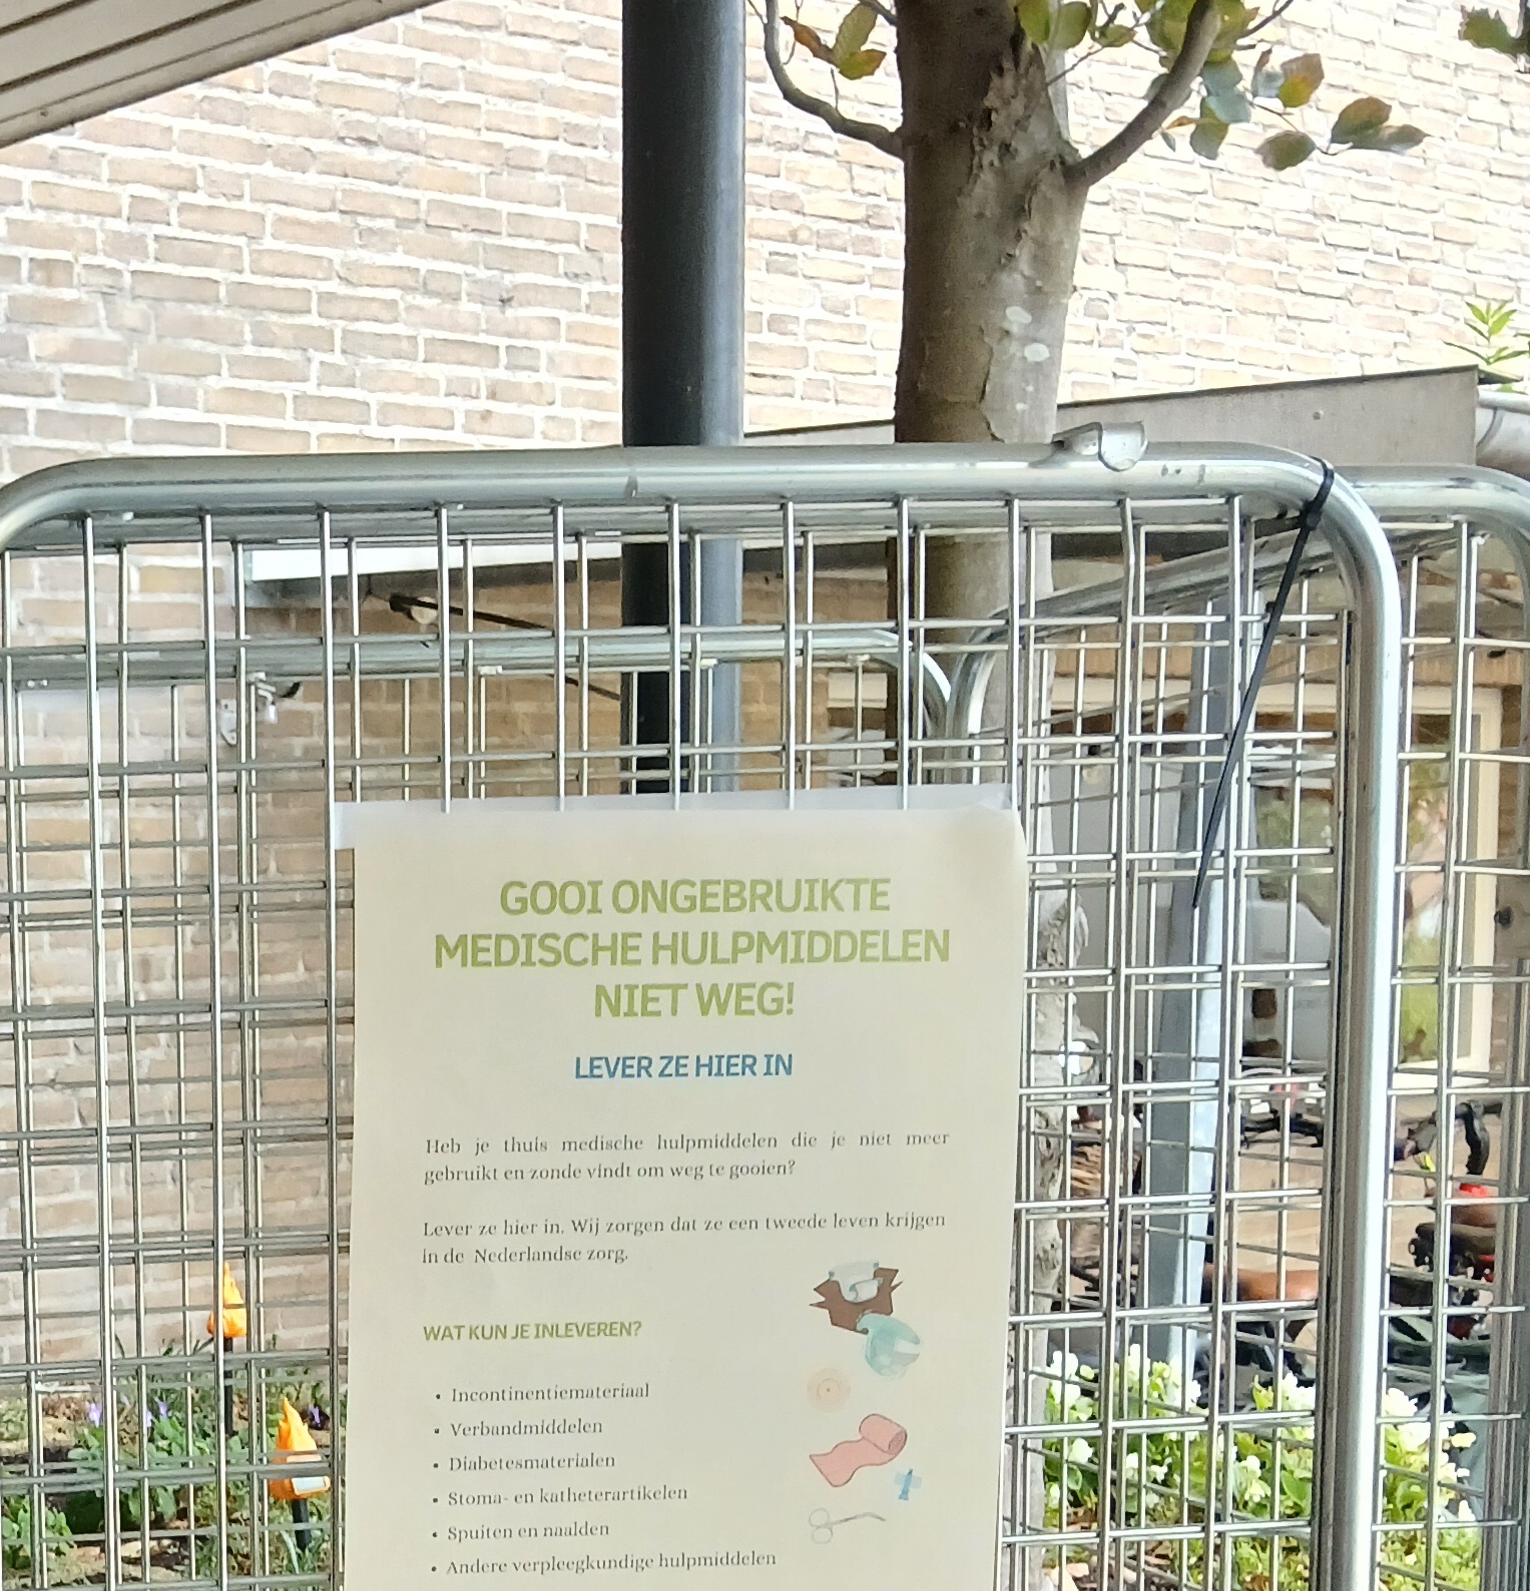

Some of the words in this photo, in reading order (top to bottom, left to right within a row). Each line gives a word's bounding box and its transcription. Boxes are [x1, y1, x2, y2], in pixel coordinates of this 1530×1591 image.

[499, 879, 603, 916] GOOI
[612, 877, 891, 914] ONGEBRUIKTE
[434, 931, 642, 968] MEDISCHE
[651, 928, 950, 966] HULPMIDDELEN
[594, 982, 688, 1018] NIET
[695, 981, 795, 1017] WEG!
[575, 1055, 653, 1080] LEVER
[658, 1055, 689, 1078] ZE
[695, 1054, 758, 1078] HIER
[763, 1053, 793, 1077] IN
[426, 1138, 461, 1154] Heb
[475, 1137, 490, 1156] je
[504, 1136, 548, 1153] thuis
[561, 1134, 643, 1152] medische
[657, 1131, 778, 1153] hulpmiddelen
[791, 1131, 818, 1148] die
[830, 1131, 846, 1151] je
[858, 1130, 892, 1147] niet
[905, 1132, 950, 1147] meer
[424, 1164, 499, 1186] gebruikt
[503, 1168, 524, 1181] en
[530, 1162, 582, 1180] zonde
[586, 1162, 632, 1179] vindt
[637, 1165, 664, 1178] om
[670, 1163, 704, 1181] weg
[708, 1162, 725, 1177] te
[729, 1160, 796, 1181] gooien?
[423, 1221, 473, 1237] Lever
[479, 1223, 497, 1236] ze
[503, 1219, 538, 1236] hier
[544, 1218, 565, 1235] in.
[571, 1217, 600, 1236] Wij
[605, 1219, 664, 1236] zorgen
[670, 1216, 697, 1232] dat
[704, 1218, 723, 1231] ze
[728, 1218, 759, 1231] een
[765, 1213, 827, 1230] tweede
[833, 1212, 879, 1229] leven
[885, 1212, 945, 1230] krijgen
[422, 1248, 438, 1264] in
[443, 1248, 464, 1264] de
[474, 1245, 582, 1264] Nederlandse
[587, 1248, 629, 1264] zorg.
[423, 1325, 465, 1341] WAT
[468, 1324, 507, 1340] KUN
[511, 1324, 530, 1339] JE
[534, 1320, 642, 1339] INLEVEREN?
[451, 1382, 649, 1402] Incontinentiemateriaal
[451, 1418, 603, 1436] Verbandmiddelen
[449, 1453, 616, 1471] Diabetesmaterialen
[448, 1490, 508, 1506] Stoma-
[514, 1491, 534, 1505] en
[539, 1484, 688, 1503] katheterartikelen
[447, 1524, 513, 1543] Spuiten
[518, 1525, 538, 1538] en
[543, 1521, 610, 1538] naalden
[445, 1557, 508, 1575] Andere
[512, 1554, 654, 1575] verpleegkundige
[658, 1551, 777, 1570] hulpmiddelen
